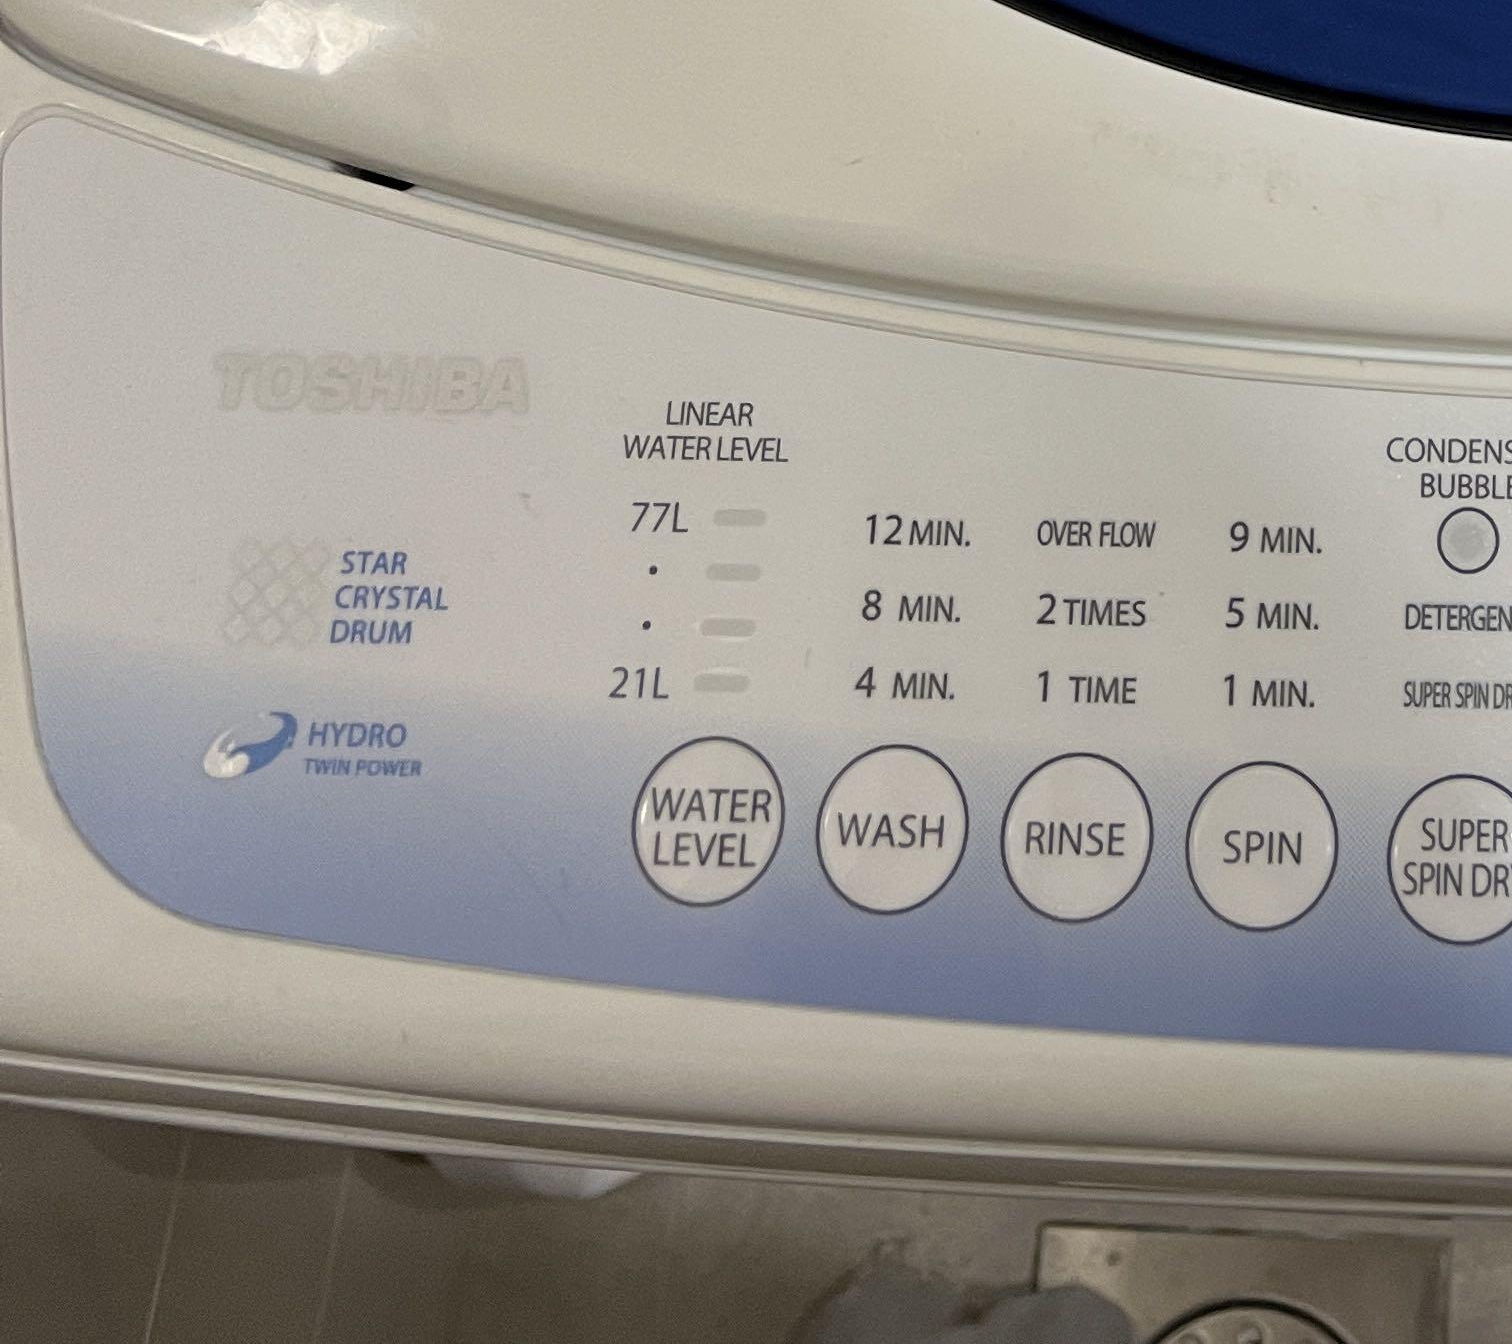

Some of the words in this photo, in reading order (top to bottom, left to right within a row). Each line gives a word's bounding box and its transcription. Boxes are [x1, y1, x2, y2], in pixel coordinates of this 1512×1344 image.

[213, 353, 529, 413] TOSHIBA
[666, 400, 754, 427] LINEAR
[623, 434, 712, 461] WATER
[716, 436, 789, 463] LEVEL
[631, 501, 689, 533] 77L
[866, 513, 903, 546] 12
[908, 519, 971, 547] MIN.
[1036, 519, 1093, 547] OVER
[1099, 520, 1157, 548] FLOW
[1229, 520, 1250, 553] 9
[1260, 526, 1323, 554] MIN.
[340, 550, 408, 576] STAR
[334, 584, 449, 611] CRYSTAL
[861, 589, 882, 622] 8
[898, 595, 961, 623] MIN.
[1036, 593, 1057, 625] 2
[1062, 598, 1146, 627] TIMES
[1225, 596, 1245, 629] 5
[1256, 602, 1319, 631] MIN.
[329, 619, 413, 645] DRUM
[608, 666, 669, 700] 21L
[854, 666, 877, 699] 4
[891, 671, 955, 700] MIN.
[1038, 670, 1049, 703] 1
[1068, 675, 1137, 705] TIME
[1224, 673, 1235, 707] 1
[1251, 679, 1315, 708] MIN.
[1403, 680, 1452, 709] SUPER
[1454, 681, 1490, 709] SPIN
[308, 721, 407, 749] HYDRO
[304, 757, 352, 776] TWIN
[355, 759, 422, 778] POWER
[651, 787, 772, 824] WATER
[837, 812, 945, 849] WASH
[1025, 821, 1126, 857] RINSE
[1223, 829, 1302, 865] SPIN
[1420, 817, 1508, 853] SUPER
[653, 831, 756, 868] LEVEL
[1402, 861, 1463, 897] SPIN
